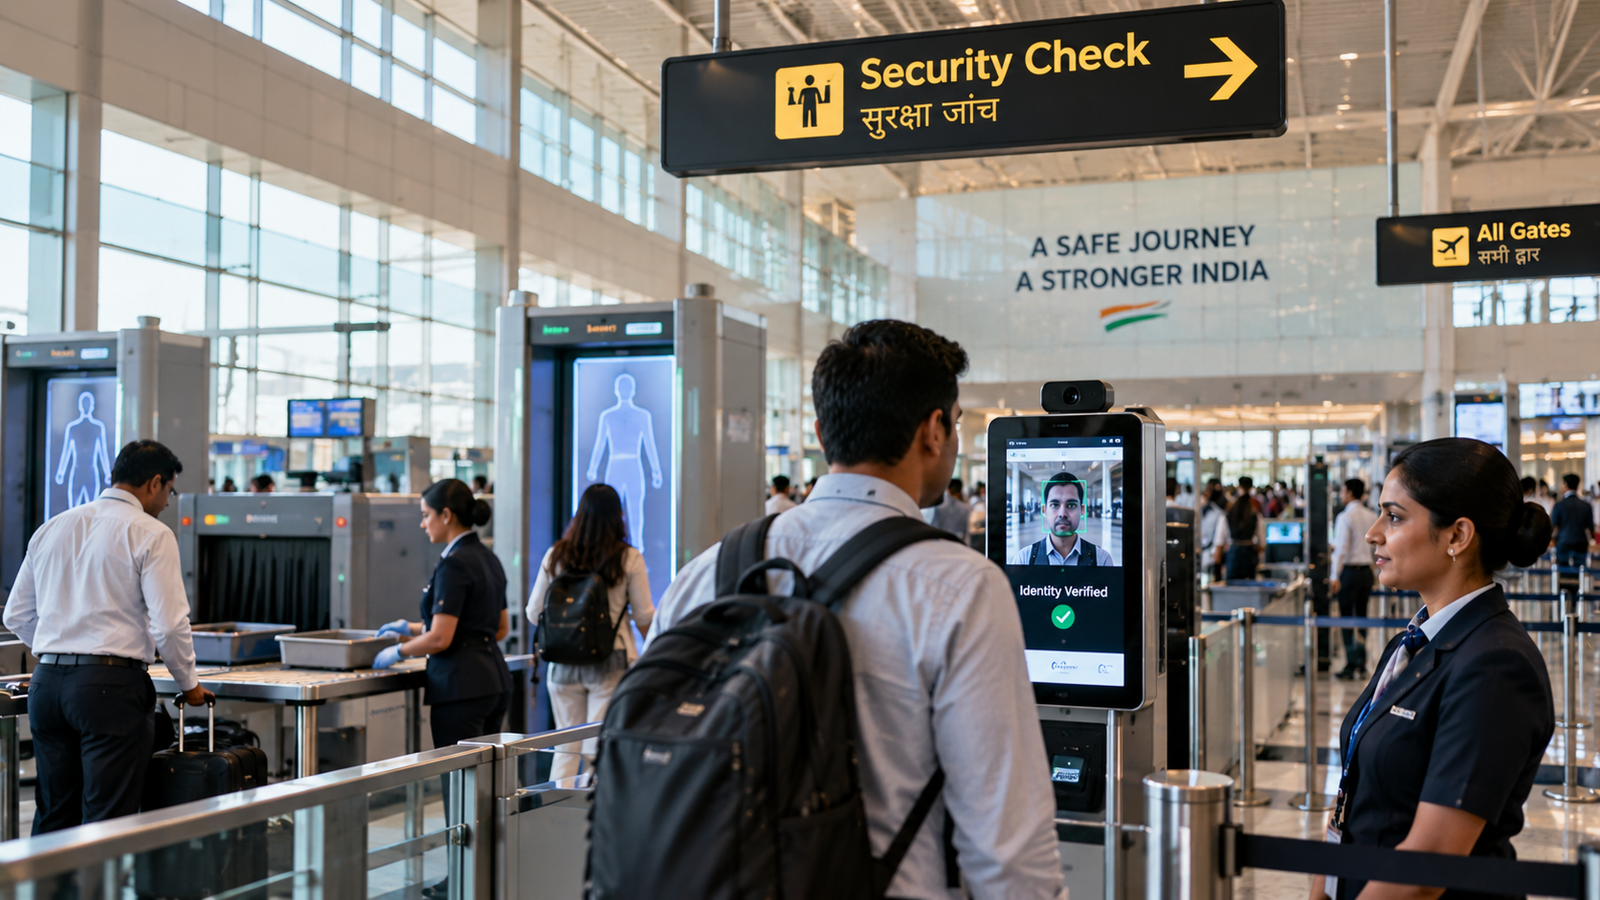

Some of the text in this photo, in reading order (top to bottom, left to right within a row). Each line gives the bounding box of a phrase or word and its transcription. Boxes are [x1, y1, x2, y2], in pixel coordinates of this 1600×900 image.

[860, 31, 1152, 91] Security Check
[859, 92, 1001, 141] सुरक्षा जांच
[1030, 224, 1255, 258] A SAFE JOURNEY
[1477, 220, 1572, 243] All Gates
[1015, 259, 1269, 292] A STRONGER INDIA
[1019, 584, 1109, 599] Identity Verified
